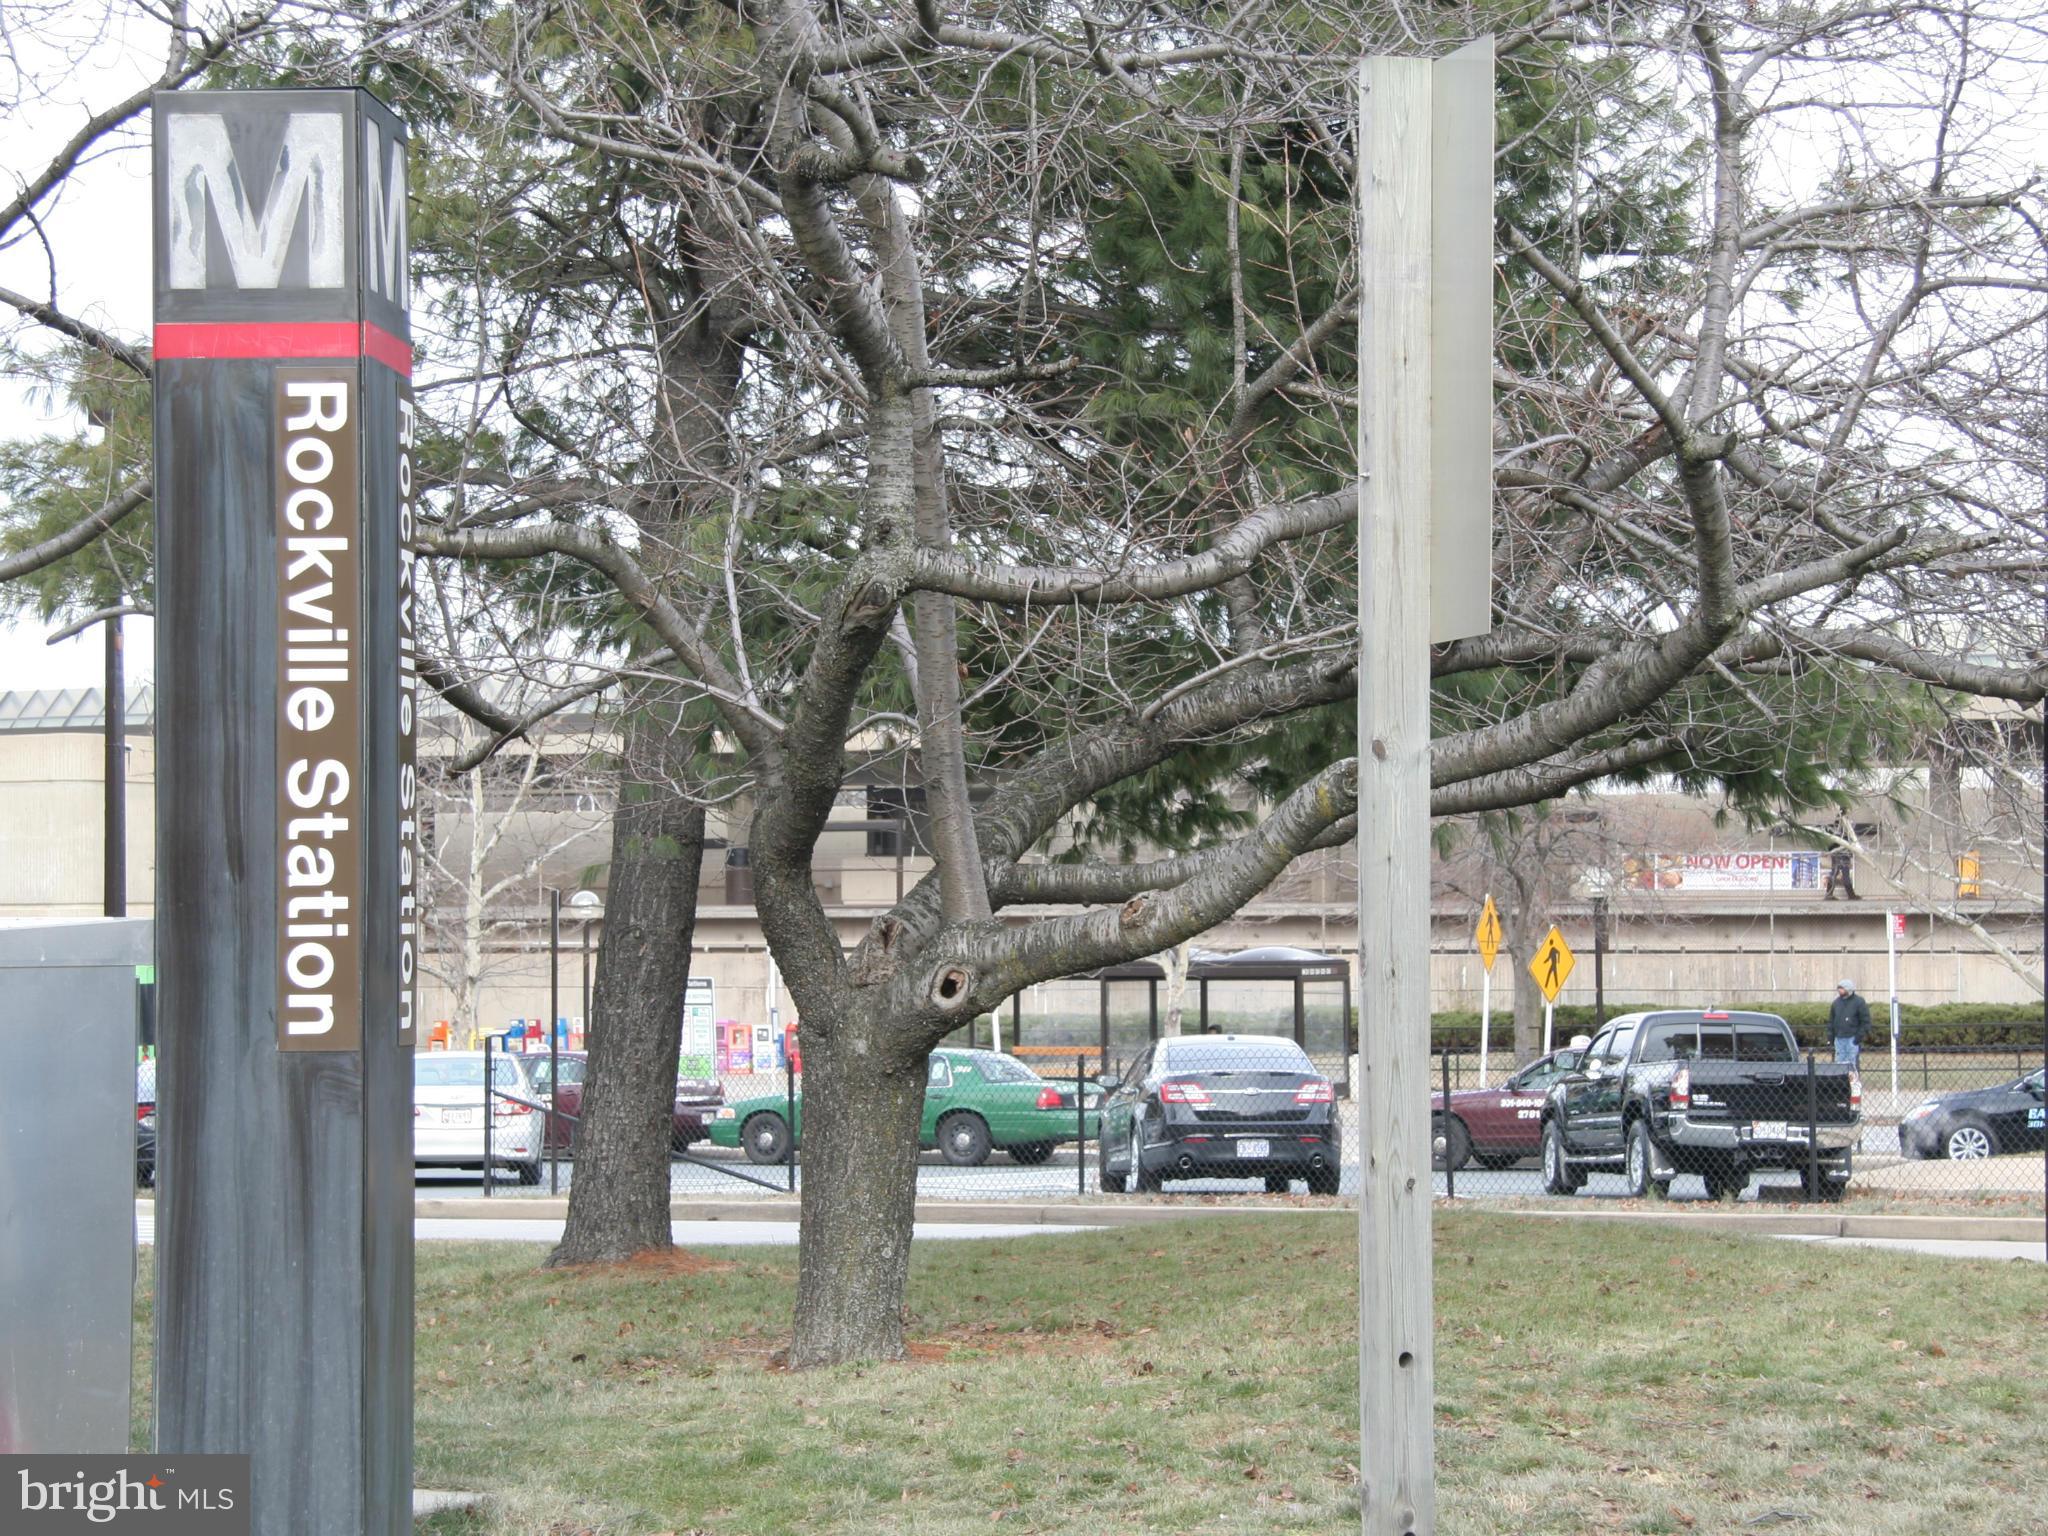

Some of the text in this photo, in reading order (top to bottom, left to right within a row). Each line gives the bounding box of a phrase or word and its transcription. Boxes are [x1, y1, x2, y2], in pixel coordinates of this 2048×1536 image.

[168, 113, 345, 289] M
[366, 117, 407, 312] M
[286, 381, 350, 1036] Rockville Station
[399, 398, 416, 1031] Rockville Station
[1686, 854, 1731, 869] NOW
